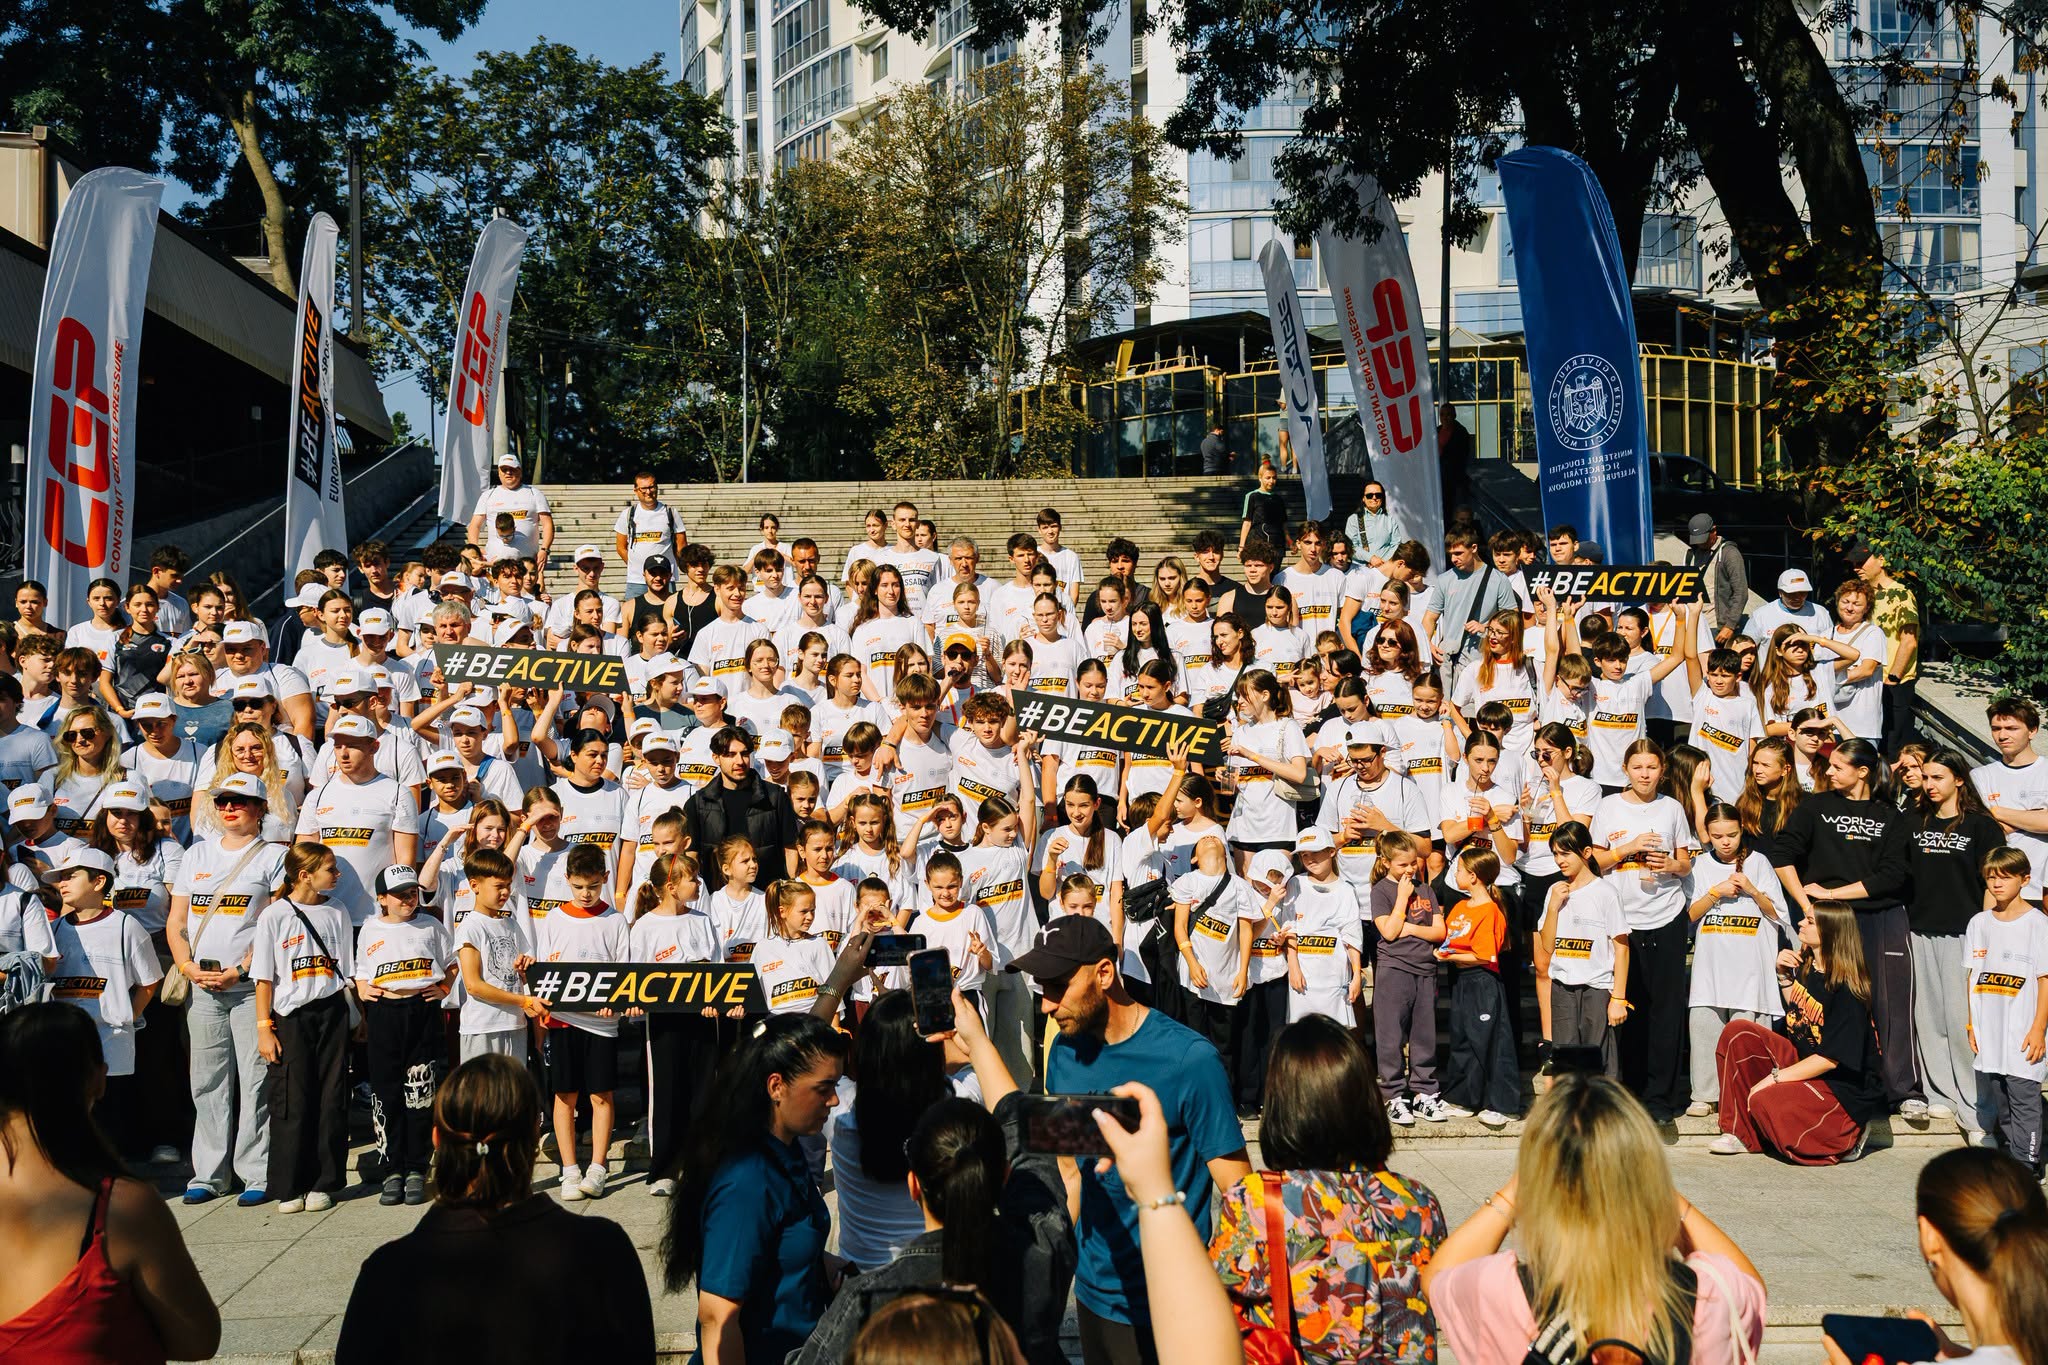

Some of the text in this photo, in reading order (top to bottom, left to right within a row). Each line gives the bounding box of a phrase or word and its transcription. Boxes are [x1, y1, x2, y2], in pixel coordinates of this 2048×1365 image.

[486, 352, 496, 387] GENTLE
[493, 310, 503, 353] PRESSURE
[456, 291, 491, 427] CEP
[300, 299, 320, 484] #BEACTIVE
[44, 317, 110, 568] CEP
[110, 340, 124, 573] CONSTANT GENTLE PRESSURE
[634, 531, 662, 539] BEACTIVE
[1528, 571, 1699, 596] #BEACTIVE
[1300, 605, 1330, 615] BEACTIVE
[714, 658, 745, 669] #BEACTI
[1185, 655, 1210, 664] BEACTI
[443, 651, 624, 687] #BEACTIVE
[1377, 703, 1414, 714] #BEACTI
[1497, 698, 1531, 709] EACTIVE
[1596, 711, 1638, 722] #BEACTIVE
[1018, 700, 1217, 755] #BEACTIVE
[1702, 722, 1744, 748] #BEACTIVE
[1407, 758, 1442, 768] #BEACTI
[1239, 766, 1272, 776] BEACTIVE
[1821, 813, 1876, 826] WORLD
[322, 828, 372, 839] #BEACTIVE
[1531, 823, 1558, 835] BEACTI
[1836, 824, 1882, 838] DANCE
[565, 833, 616, 843] #BEACTIVE
[1912, 831, 1960, 842] WORLD
[1918, 838, 1967, 851] DANCE
[192, 895, 250, 906] #BECTIVE
[528, 898, 566, 909] BEACTI
[1197, 915, 1230, 935] EACTIVE
[1706, 914, 1759, 927] #BEACTIVE
[1296, 936, 1336, 947] EACTIVE
[1555, 938, 1593, 951] EACTIVE
[377, 958, 432, 977] #BEACTIVE
[534, 970, 754, 1003] #BEACTIVE
[773, 978, 818, 996] #BEACTI
